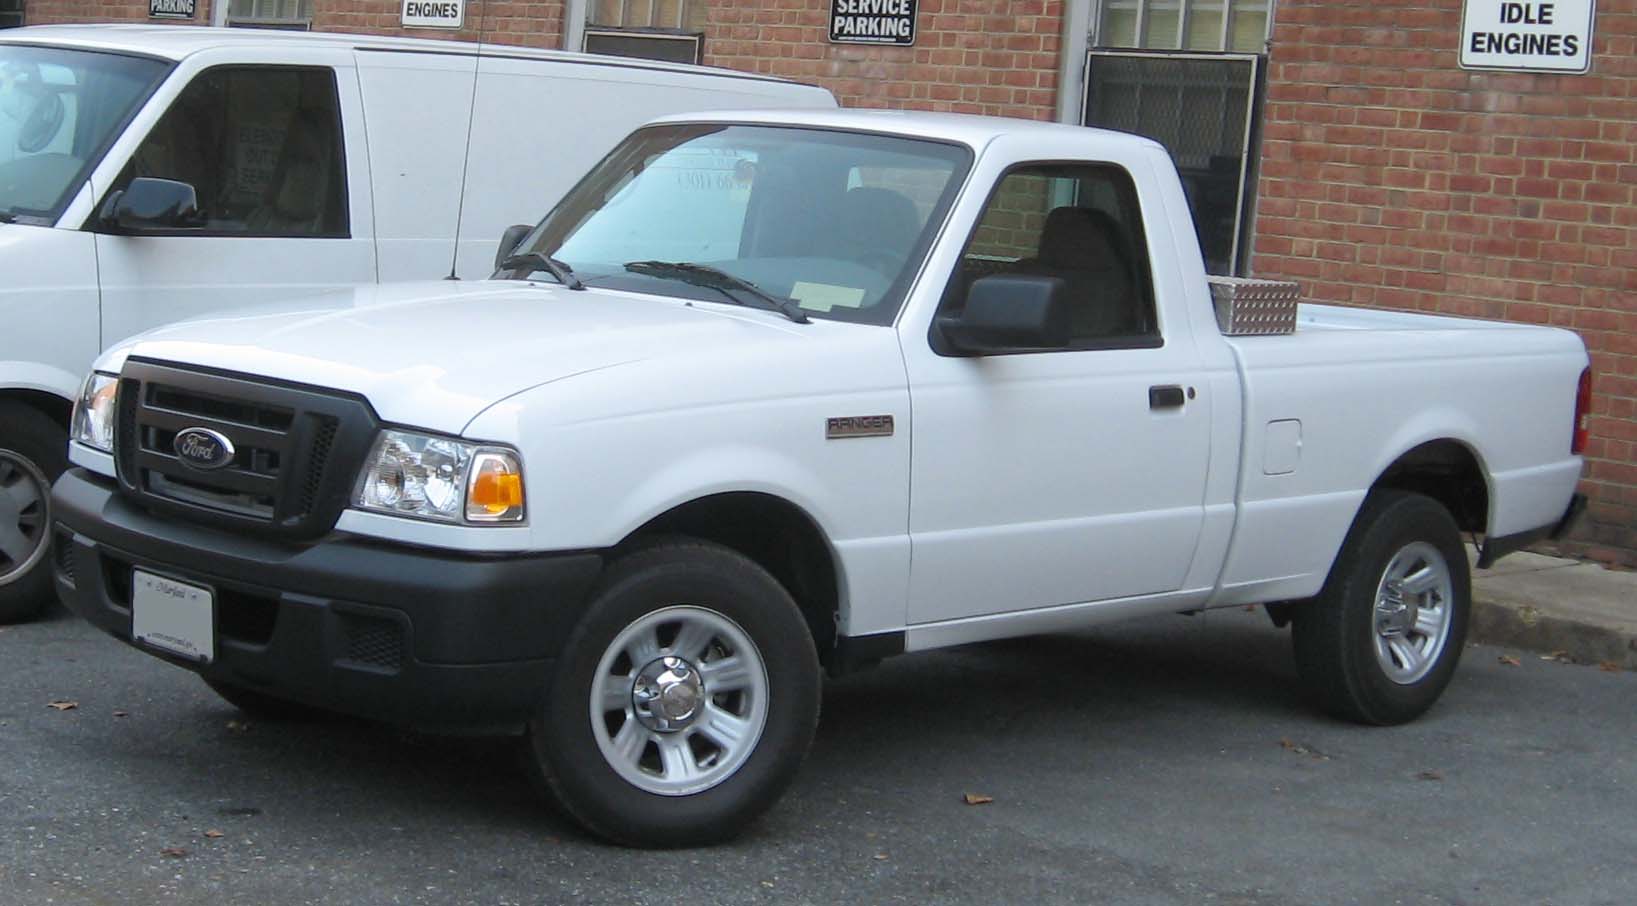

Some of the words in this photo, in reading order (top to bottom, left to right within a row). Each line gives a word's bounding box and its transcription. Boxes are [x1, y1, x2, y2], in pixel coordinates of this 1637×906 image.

[151, 0, 193, 13] PARKING
[406, 2, 458, 18] ENGINES
[837, 0, 911, 15] SERVICE
[1499, 2, 1554, 25] IDLE
[834, 16, 911, 36] PARKING
[1470, 32, 1579, 57] ENGINES
[828, 416, 894, 433] RANGER
[182, 432, 217, 460] Ford
